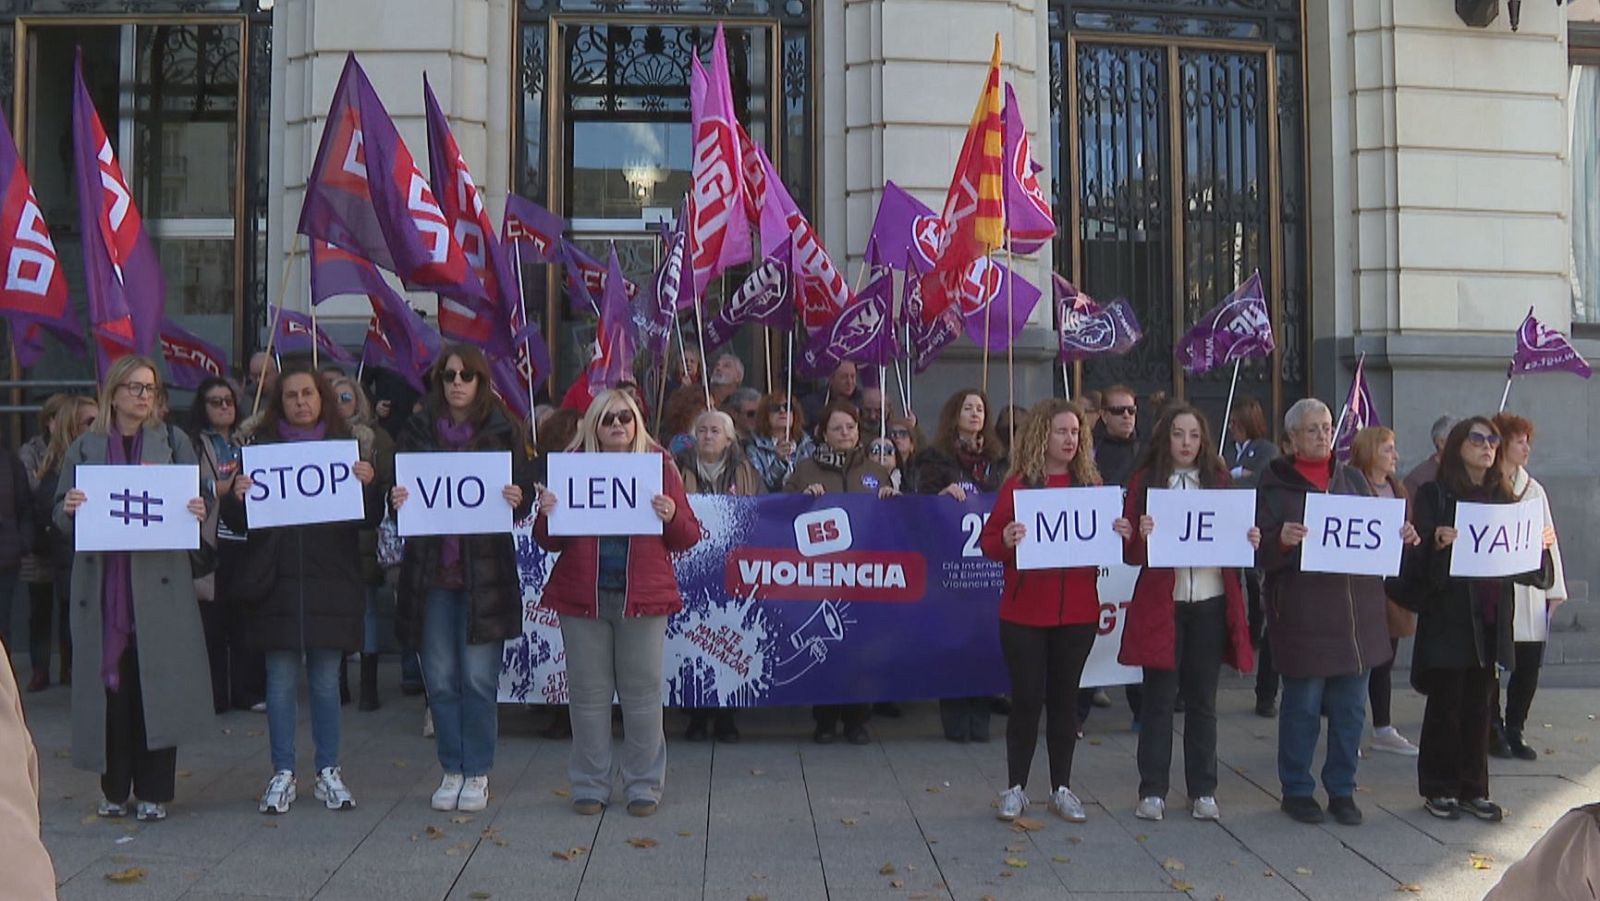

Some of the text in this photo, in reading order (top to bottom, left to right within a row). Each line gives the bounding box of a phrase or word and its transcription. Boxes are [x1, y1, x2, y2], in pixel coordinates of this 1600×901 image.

[250, 462, 350, 501] STOP
[416, 475, 485, 509] VIO
[568, 477, 637, 509] LEN
[110, 489, 163, 526] #
[807, 519, 840, 544] ES
[962, 513, 991, 557] 2
[1036, 509, 1097, 543] MU
[1179, 511, 1216, 542] JE
[1322, 516, 1382, 550] RES
[1469, 519, 1531, 554] YA!!
[738, 559, 907, 589] VIOLENCIA
[942, 579, 989, 589] Violencia
